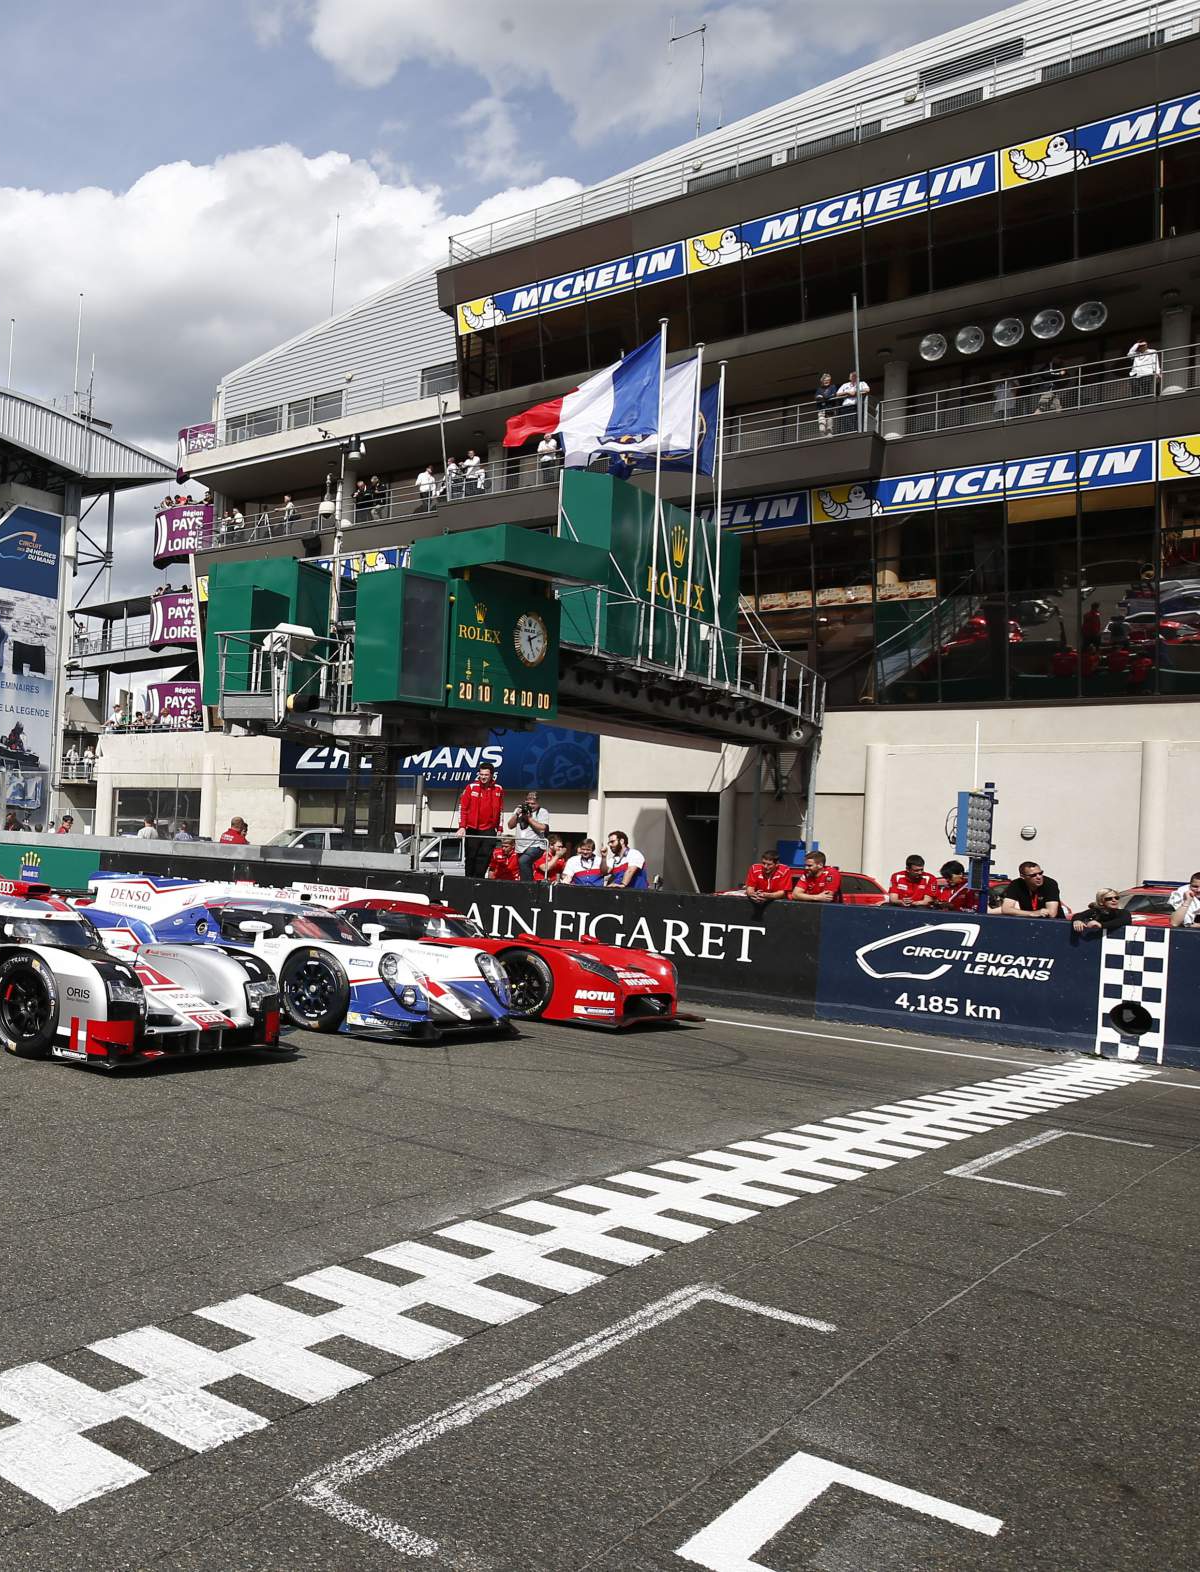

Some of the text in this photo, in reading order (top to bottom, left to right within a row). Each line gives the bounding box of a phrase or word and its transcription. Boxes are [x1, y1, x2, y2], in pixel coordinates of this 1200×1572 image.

[760, 161, 986, 243] MICHELIN
[512, 249, 676, 312] MICHELIN
[892, 449, 1142, 504] MICHELIN
[172, 517, 203, 531] PAYS
[19, 539, 43, 549] CIRCUIT
[36, 556, 56, 566] MANS
[459, 624, 501, 644] ROLEX
[164, 696, 196, 709] PAYS
[459, 683, 550, 709] 20 10 24 00 00
[5, 704, 14, 713] LA
[16, 706, 50, 718] LEGENDE
[402, 745, 504, 769] MANS
[450, 771, 472, 781] JUIN
[110, 888, 151, 903] DENSO
[303, 884, 336, 894] NISSAN
[553, 910, 766, 963] FIGARET
[902, 946, 1055, 969] CIRCUIT BUGATTI
[964, 963, 1050, 981] LE MANS
[67, 987, 90, 999] ORIS
[575, 990, 615, 1002] MOTUL
[895, 992, 1001, 1020] 4,185 km
[365, 1017, 411, 1027] MICHELIN
